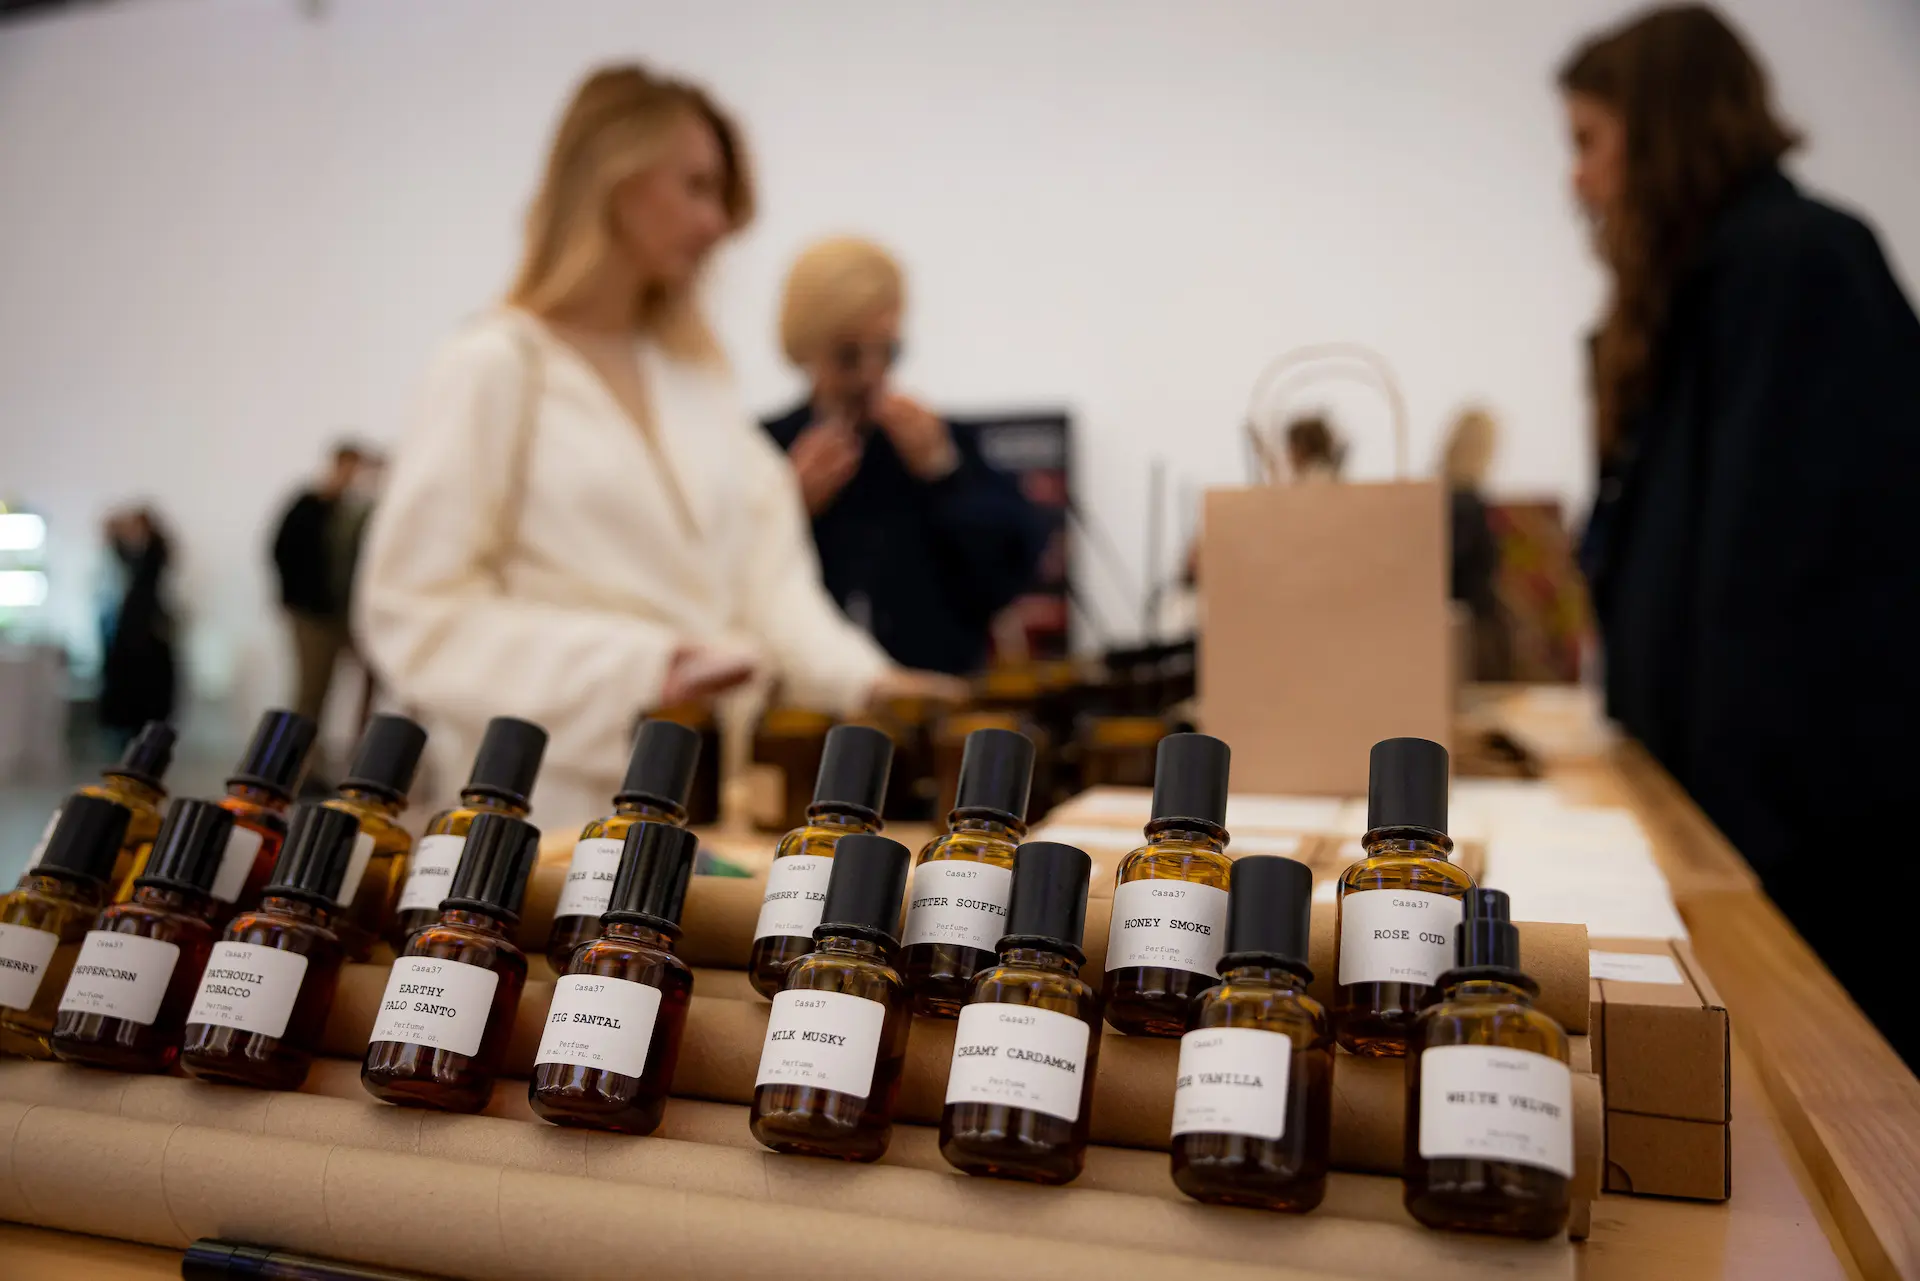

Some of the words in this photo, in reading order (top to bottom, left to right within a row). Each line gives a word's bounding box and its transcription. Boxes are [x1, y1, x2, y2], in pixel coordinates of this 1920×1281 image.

[592, 871, 616, 882] LAB
[945, 870, 978, 878] Casa37
[1152, 889, 1186, 898] Casa37
[912, 897, 948, 910] BUTTER
[1393, 899, 1429, 909] Casa37
[936, 923, 969, 932] Perfume
[1124, 918, 1161, 929] HONEY
[1169, 920, 1211, 935] SMOKE
[1374, 929, 1410, 940] ROSE
[1420, 932, 1446, 945] OUD
[1145, 945, 1180, 954] Perfume
[411, 964, 442, 974] Casa37
[205, 984, 251, 998] TOBACCO
[399, 984, 445, 998] EARTHY
[574, 984, 605, 993] Casa37
[385, 1000, 407, 1011] PALO
[413, 1002, 456, 1018] SANTO
[795, 999, 826, 1008] Casa37
[551, 1012, 568, 1023] FIG
[572, 1013, 621, 1029] SANTAL
[999, 1014, 1036, 1025] Casa37
[393, 1021, 425, 1031] Perfume
[772, 1030, 796, 1041] MILK
[802, 1031, 846, 1046] MUSKY
[559, 1041, 590, 1050] Perfume
[958, 1045, 999, 1057] CREAMY
[1006, 1048, 1076, 1073] CARDAMOM
[1198, 1072, 1263, 1088] VANILLA
[1446, 1091, 1498, 1105] WHITE
